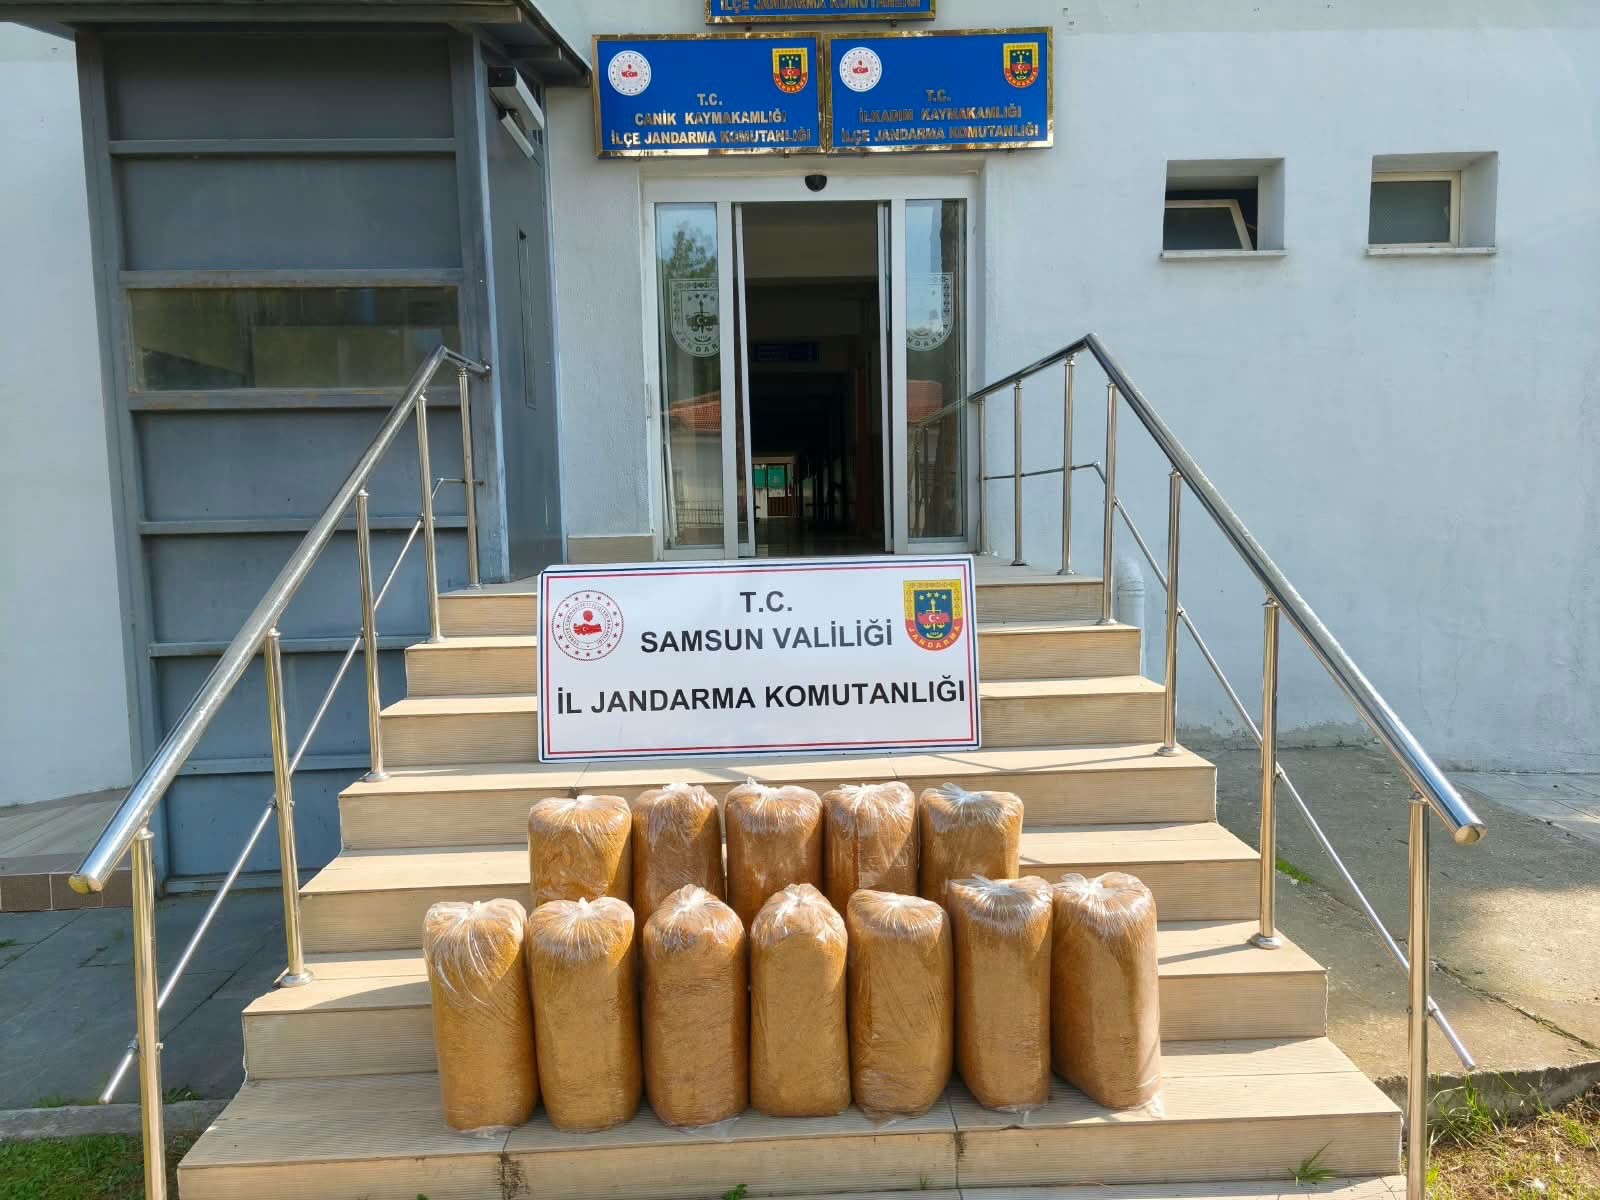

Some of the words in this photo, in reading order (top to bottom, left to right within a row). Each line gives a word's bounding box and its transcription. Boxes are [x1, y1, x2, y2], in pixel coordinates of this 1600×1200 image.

[697, 93, 723, 106] T.C.
[926, 89, 952, 103] T.C.
[635, 110, 677, 126] CANİK
[685, 108, 787, 125] KAYMAKAMLIĞI
[859, 107, 914, 123] İLKADIM
[920, 103, 1022, 121] KAYMAKAMLIĞI
[611, 129, 641, 148] İLÇE
[644, 130, 717, 144] JANDARMA
[720, 127, 811, 143] KOMUTANLIĞI
[841, 127, 870, 145] İLÇE
[874, 127, 945, 142] JANDARMA
[950, 121, 1040, 138] KOMUTANLIĞI
[739, 590, 793, 613] T.C.
[640, 628, 763, 653] SAMSUN
[772, 619, 893, 649] VALİLİĞİ
[908, 625, 961, 649] JANDARMA
[557, 687, 582, 714] İL
[590, 686, 756, 714] JANDARMA
[765, 675, 965, 708] KOMUTANLIĞI
